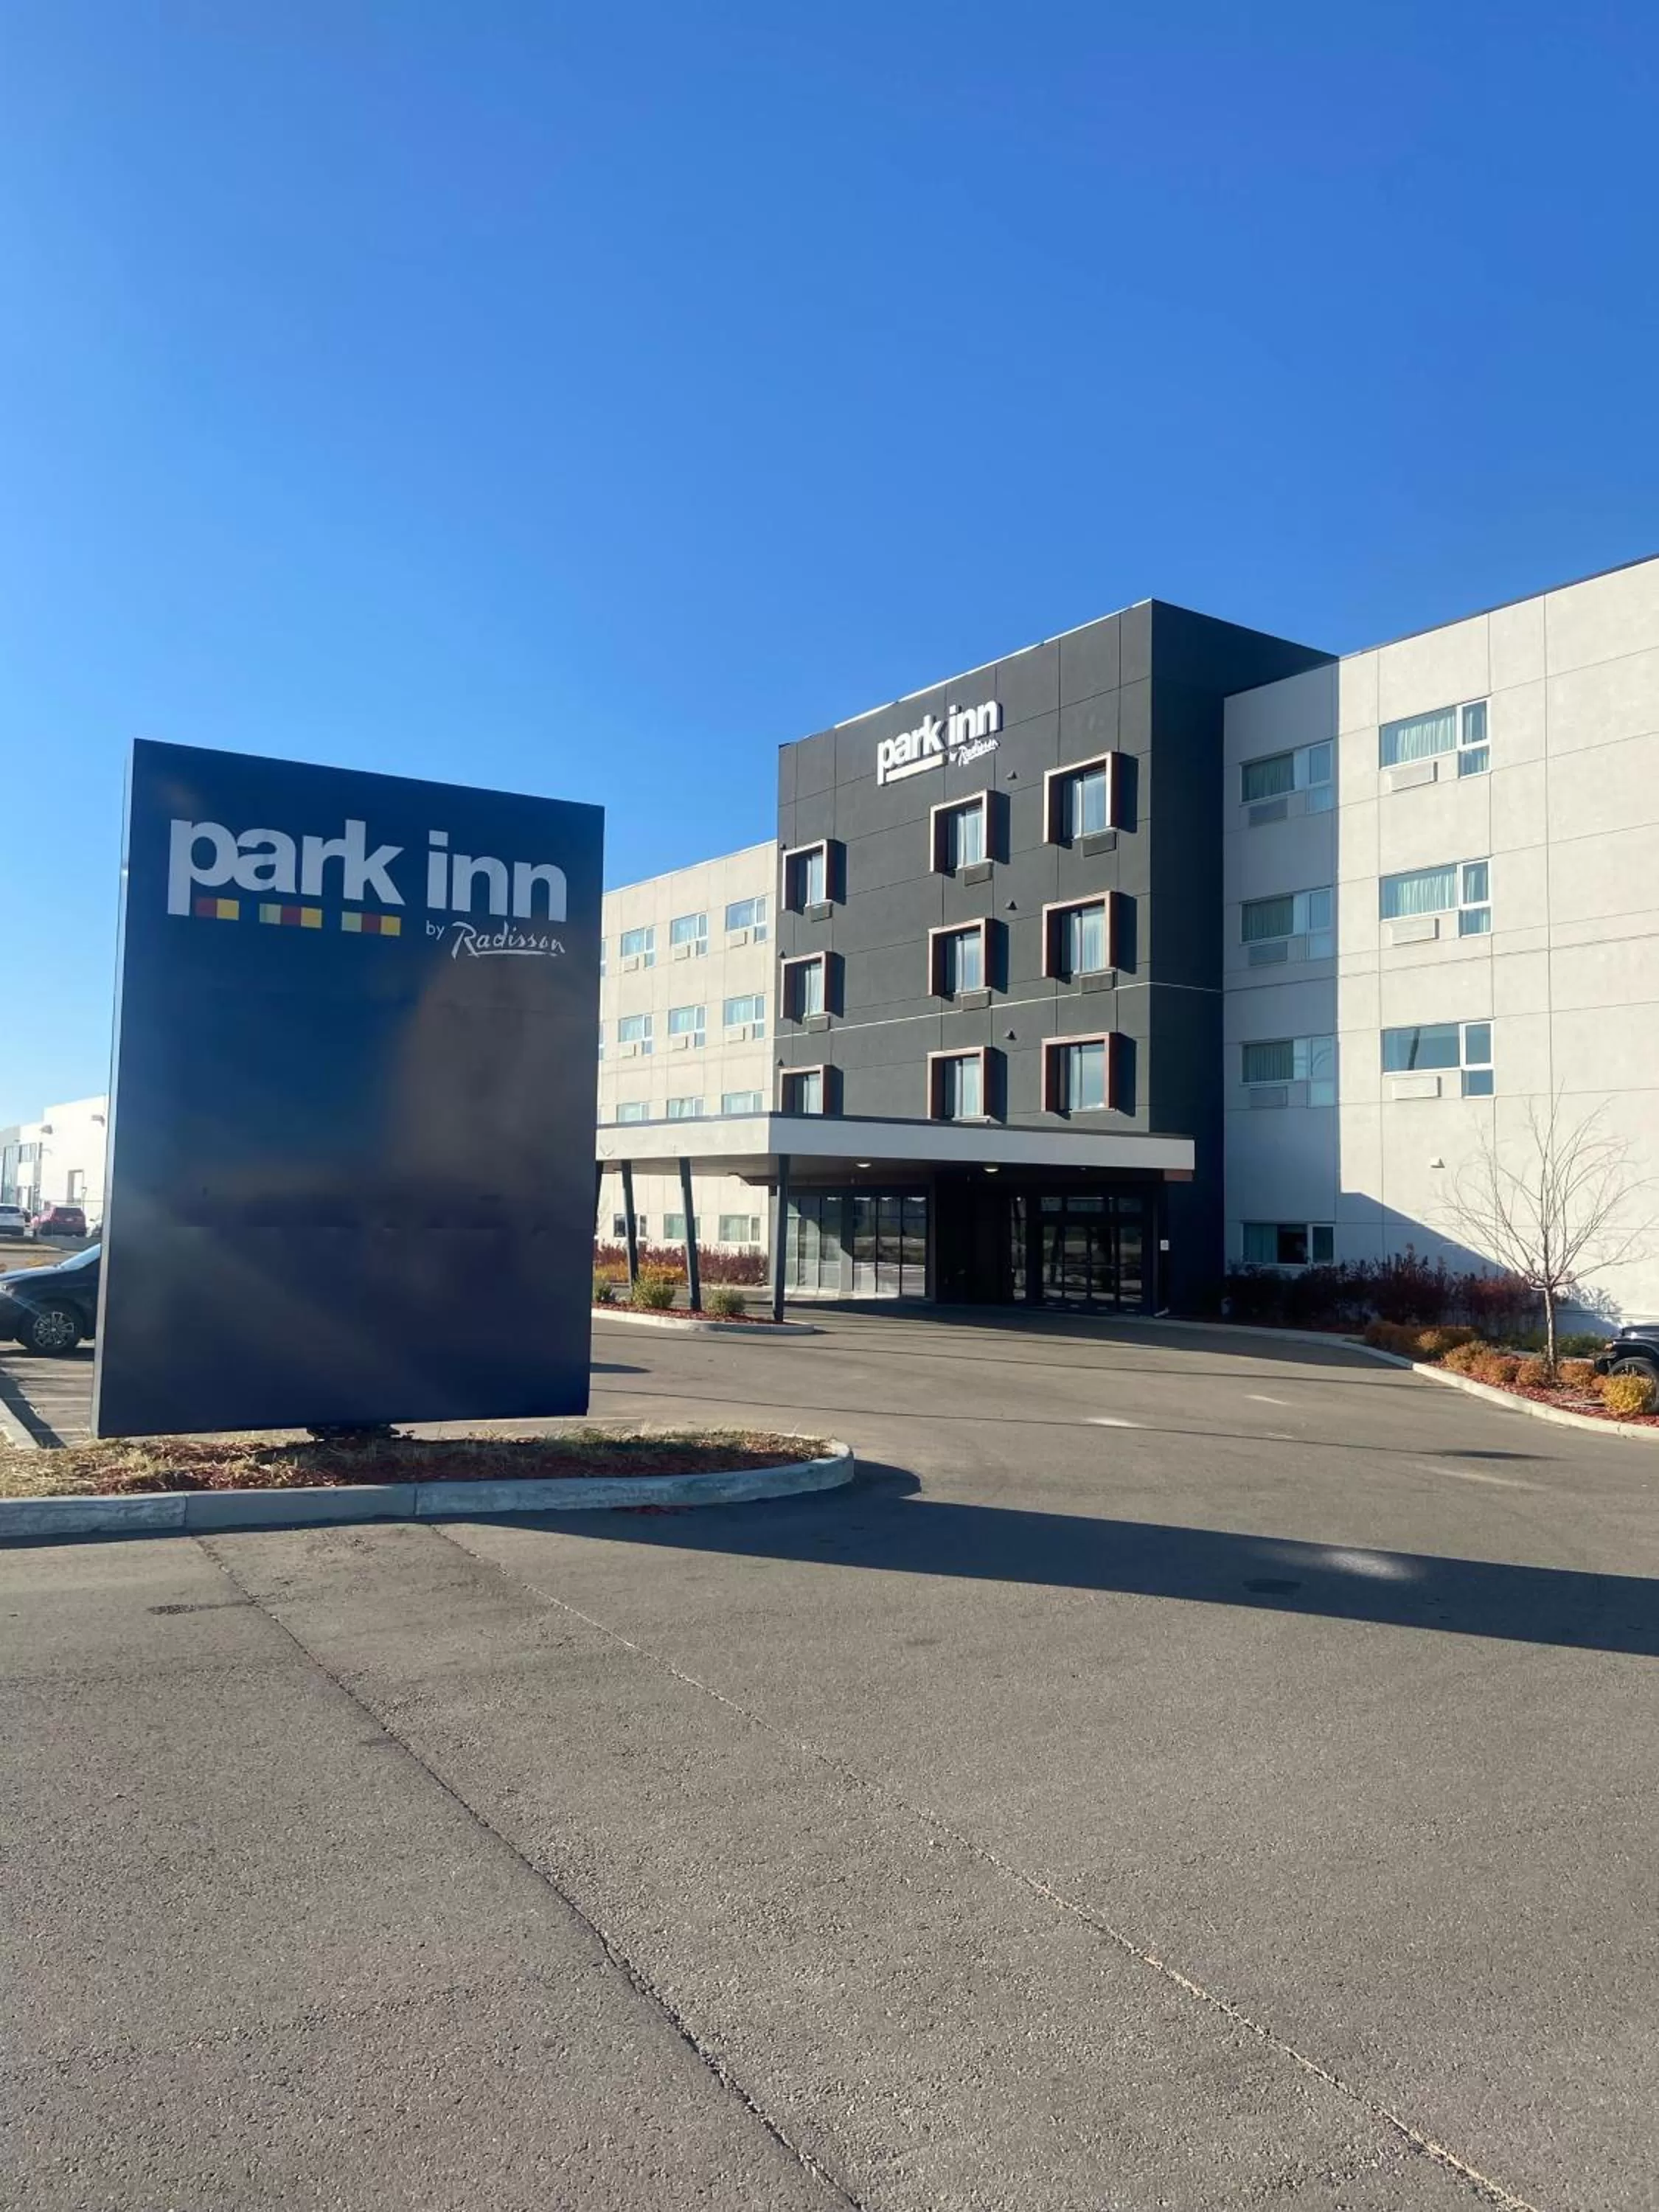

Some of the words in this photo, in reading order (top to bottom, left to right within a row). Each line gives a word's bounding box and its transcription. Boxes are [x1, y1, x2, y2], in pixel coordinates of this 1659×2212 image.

[877, 714, 943, 785] park
[949, 700, 999, 746] inn
[167, 819, 405, 916] park
[427, 830, 566, 922] inn
[426, 920, 444, 940] by
[451, 921, 566, 960] Radisson
